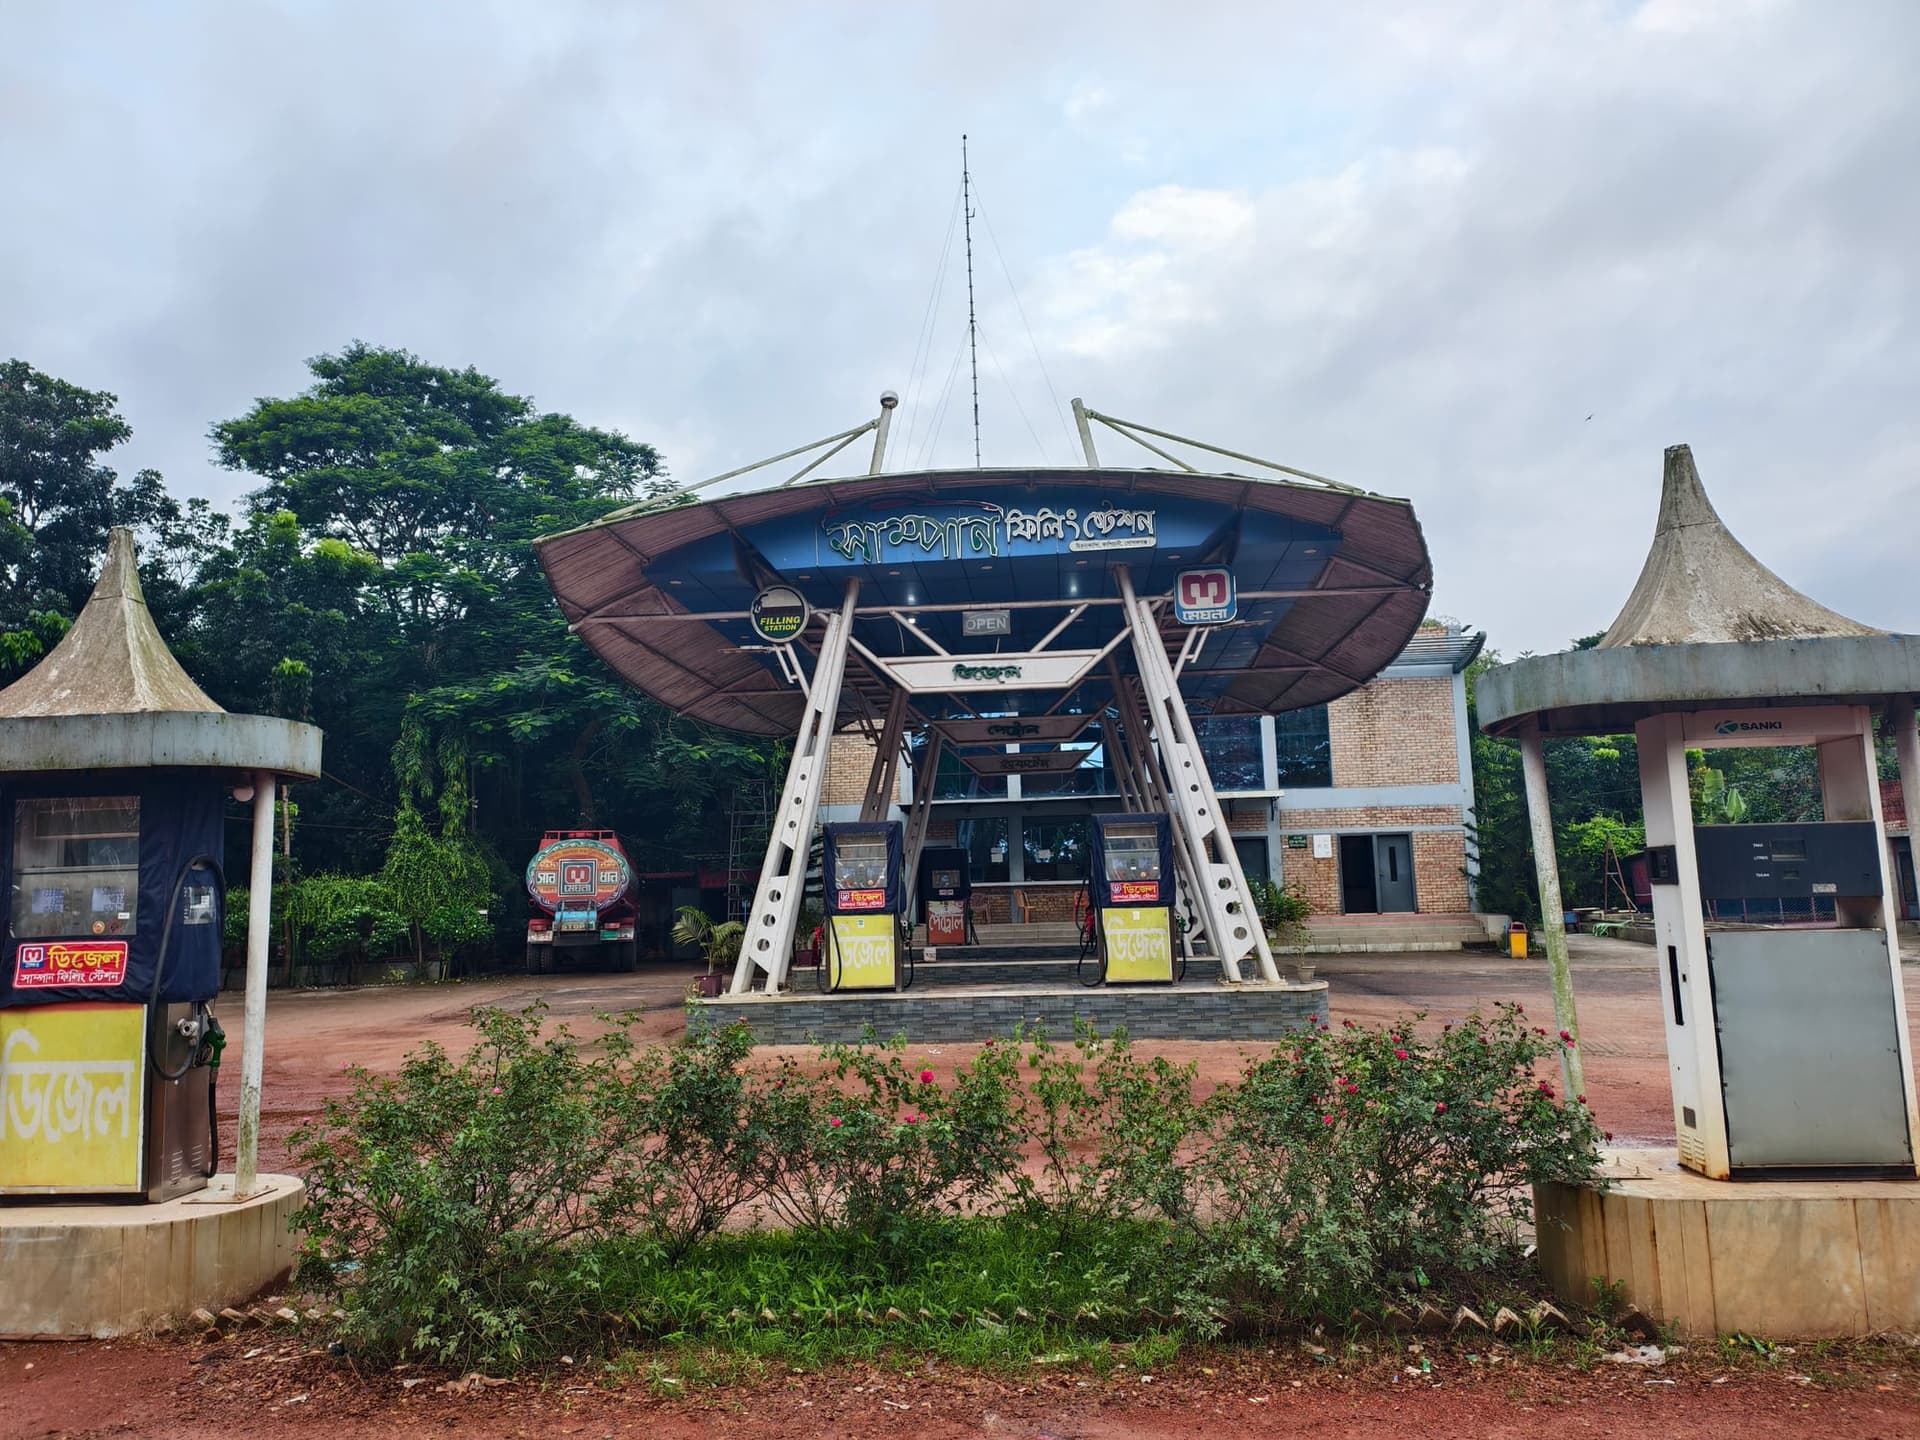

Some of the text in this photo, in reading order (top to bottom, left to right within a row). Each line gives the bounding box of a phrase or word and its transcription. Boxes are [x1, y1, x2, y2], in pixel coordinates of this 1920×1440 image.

[826, 514, 1000, 563] সাম্পান
[1005, 508, 1081, 544] ফিলিং
[760, 616, 801, 625] FILLING
[764, 624, 797, 632] STATION
[966, 616, 1007, 630] OPEN
[1741, 721, 1783, 730] SANKI
[1122, 883, 1157, 895] ডিজেল
[832, 923, 893, 969] ডিজেল
[1107, 915, 1166, 962] ডিজেল
[47, 945, 124, 970] ডিজেল
[0, 1028, 135, 1143] ডিজেল
